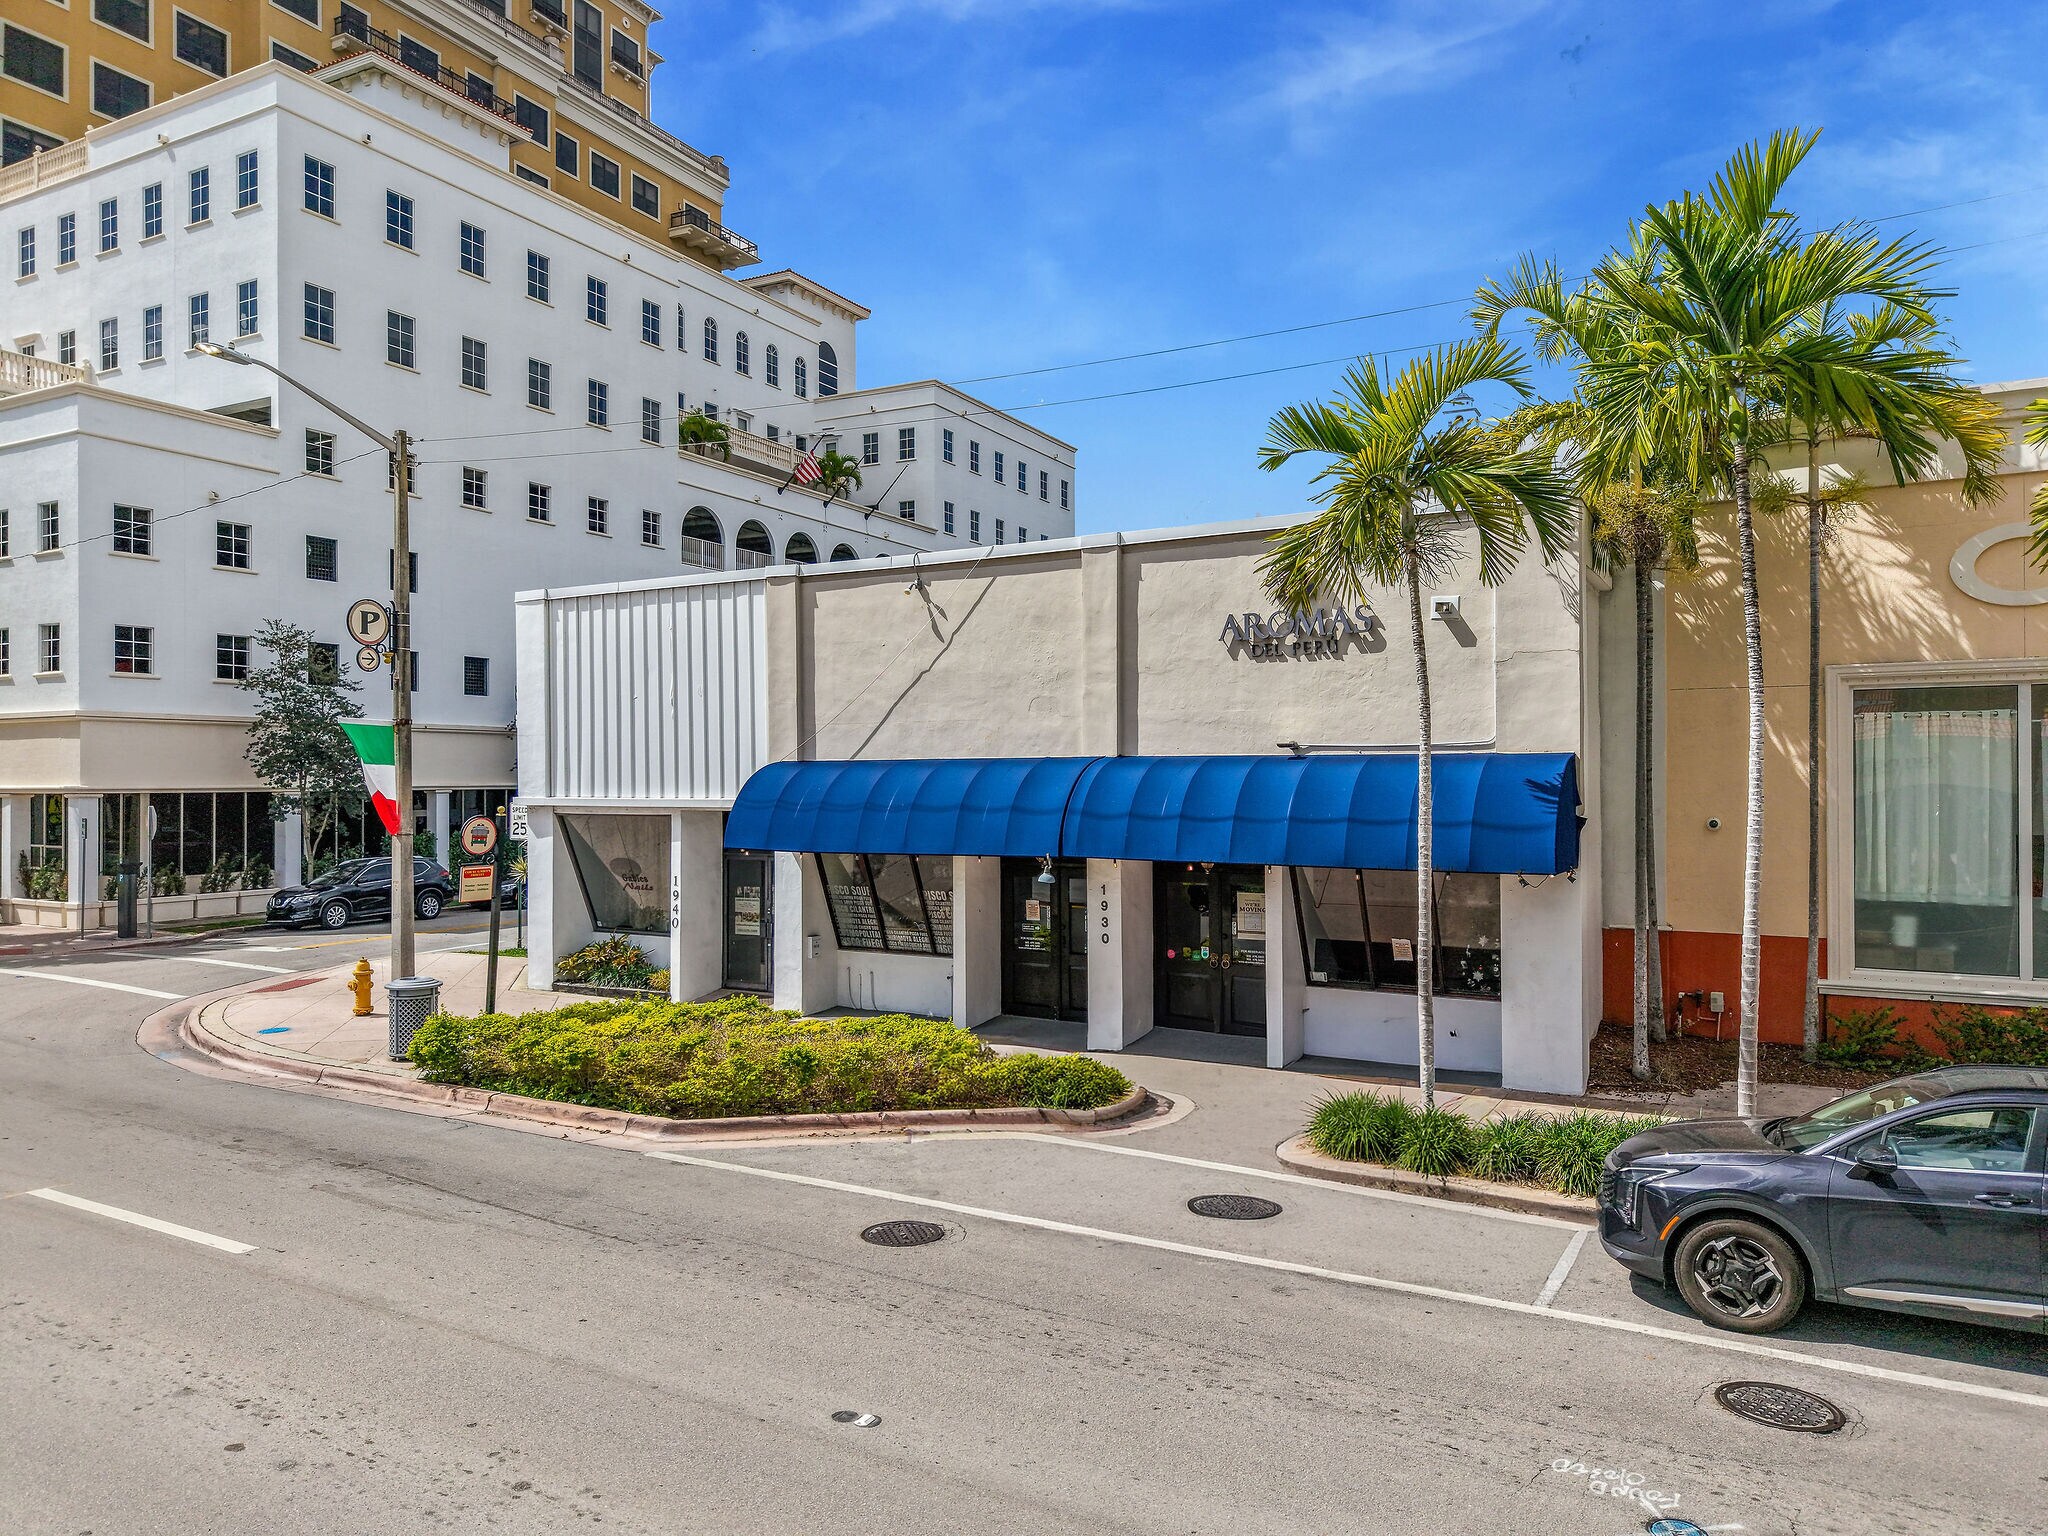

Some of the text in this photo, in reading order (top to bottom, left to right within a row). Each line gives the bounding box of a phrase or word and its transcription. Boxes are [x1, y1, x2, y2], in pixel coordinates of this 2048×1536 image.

[359, 610, 381, 635] P
[1218, 605, 1372, 641] AROMAS
[1252, 643, 1284, 658] DEL
[512, 822, 527, 836] 25
[671, 875, 679, 929] 1940
[1100, 884, 1110, 944] 1930
